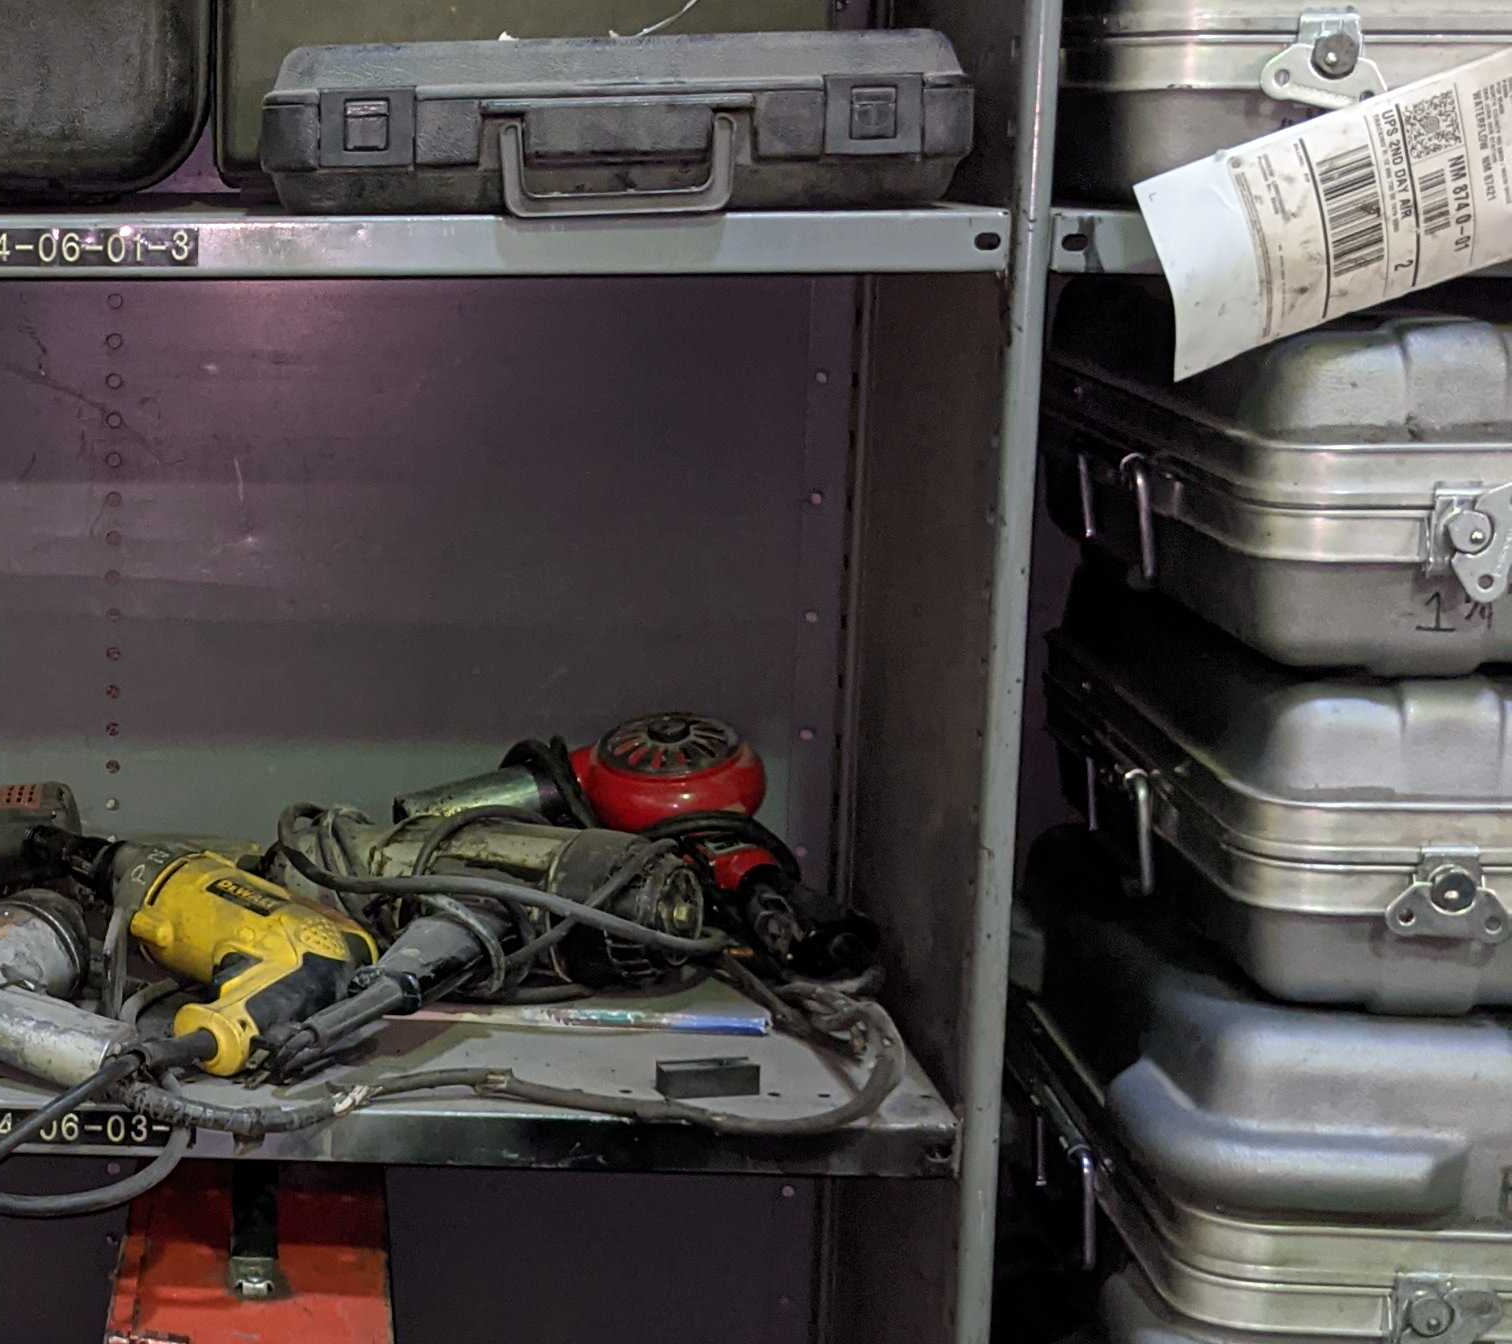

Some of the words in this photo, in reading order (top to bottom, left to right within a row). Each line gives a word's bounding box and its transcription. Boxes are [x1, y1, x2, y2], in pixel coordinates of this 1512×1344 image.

[1381, 109, 1399, 137] UPS
[1472, 89, 1488, 150] WATERFLOW
[1388, 139, 1405, 166] 2ND
[1394, 168, 1411, 194] DAY
[1448, 154, 1467, 182] NM
[1399, 197, 1413, 220] AIR
[1451, 183, 1471, 212] 874
